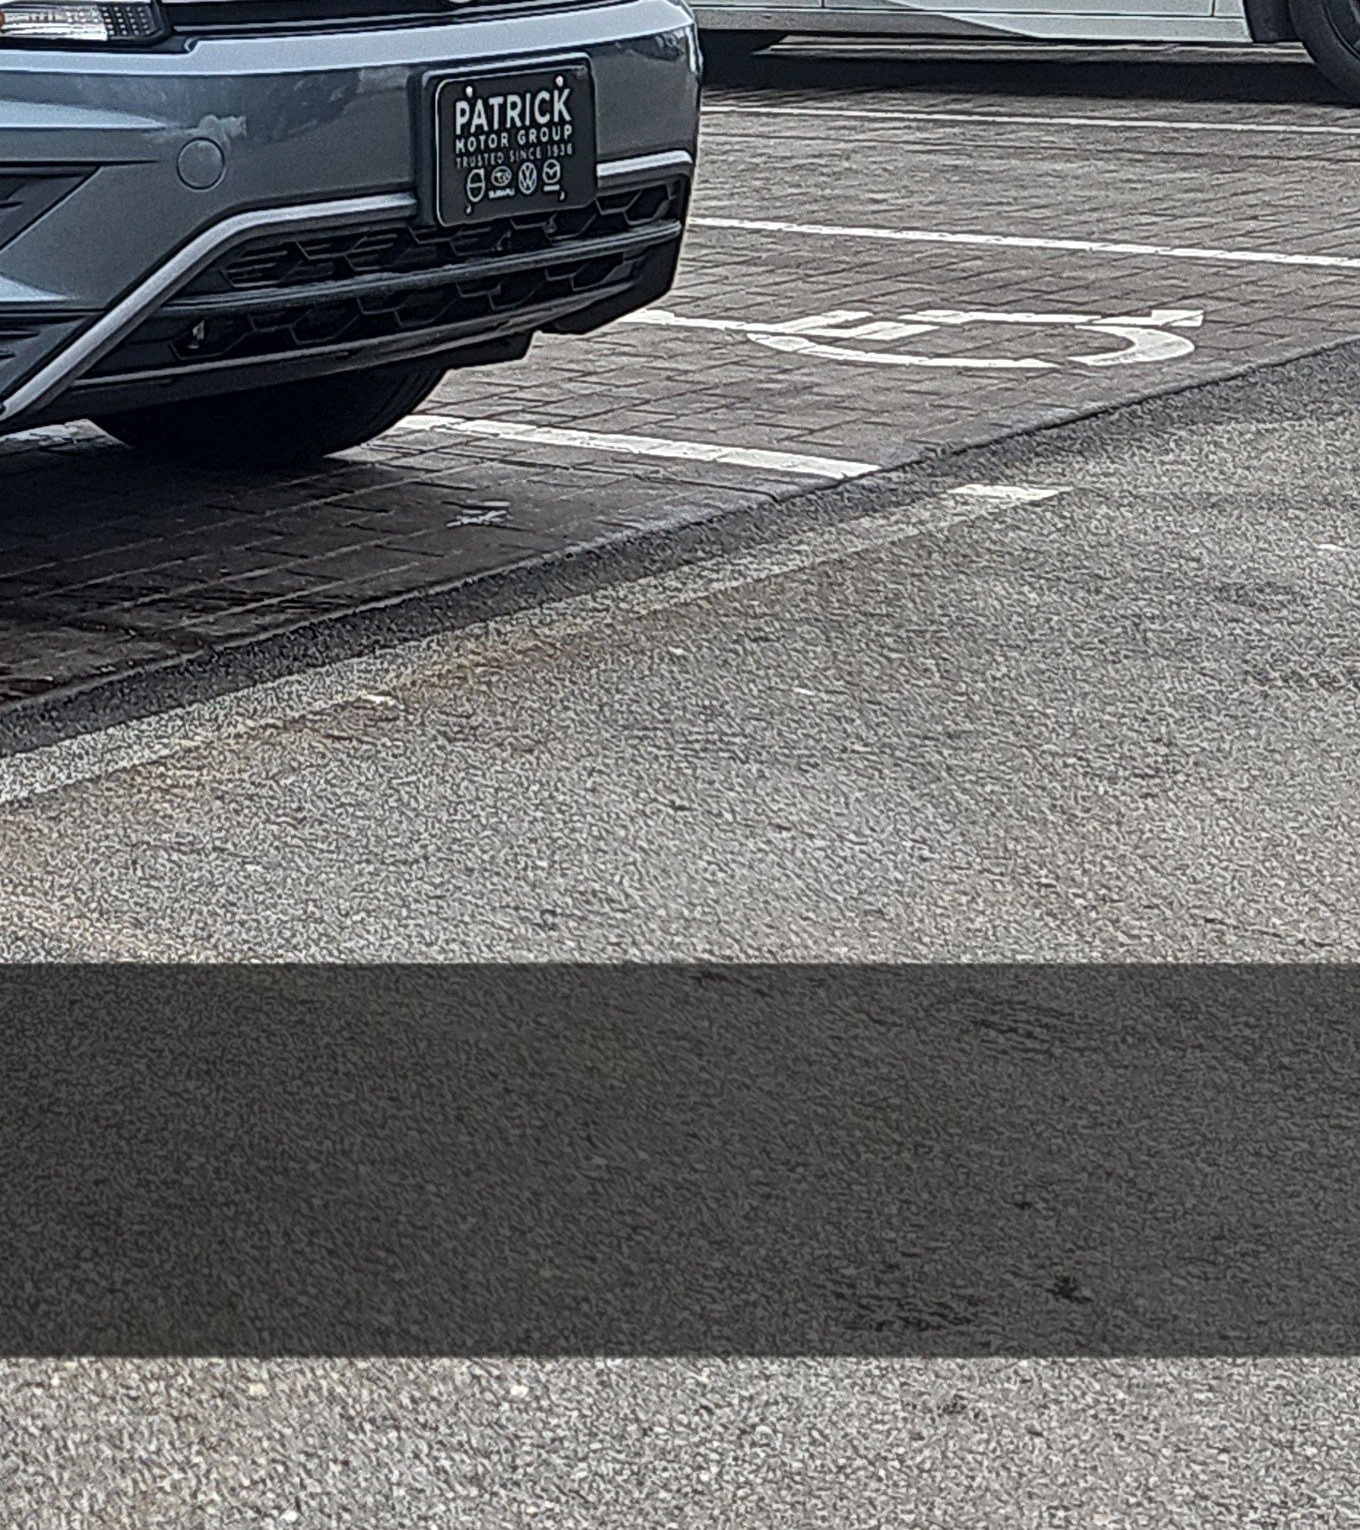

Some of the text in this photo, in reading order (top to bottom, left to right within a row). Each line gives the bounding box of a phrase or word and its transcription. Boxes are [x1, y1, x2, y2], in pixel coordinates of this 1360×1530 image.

[454, 87, 572, 135] PATRICK
[454, 124, 573, 154] MOTOR GROUP
[454, 151, 504, 169] TRUSTED
[509, 146, 542, 162] SINCE
